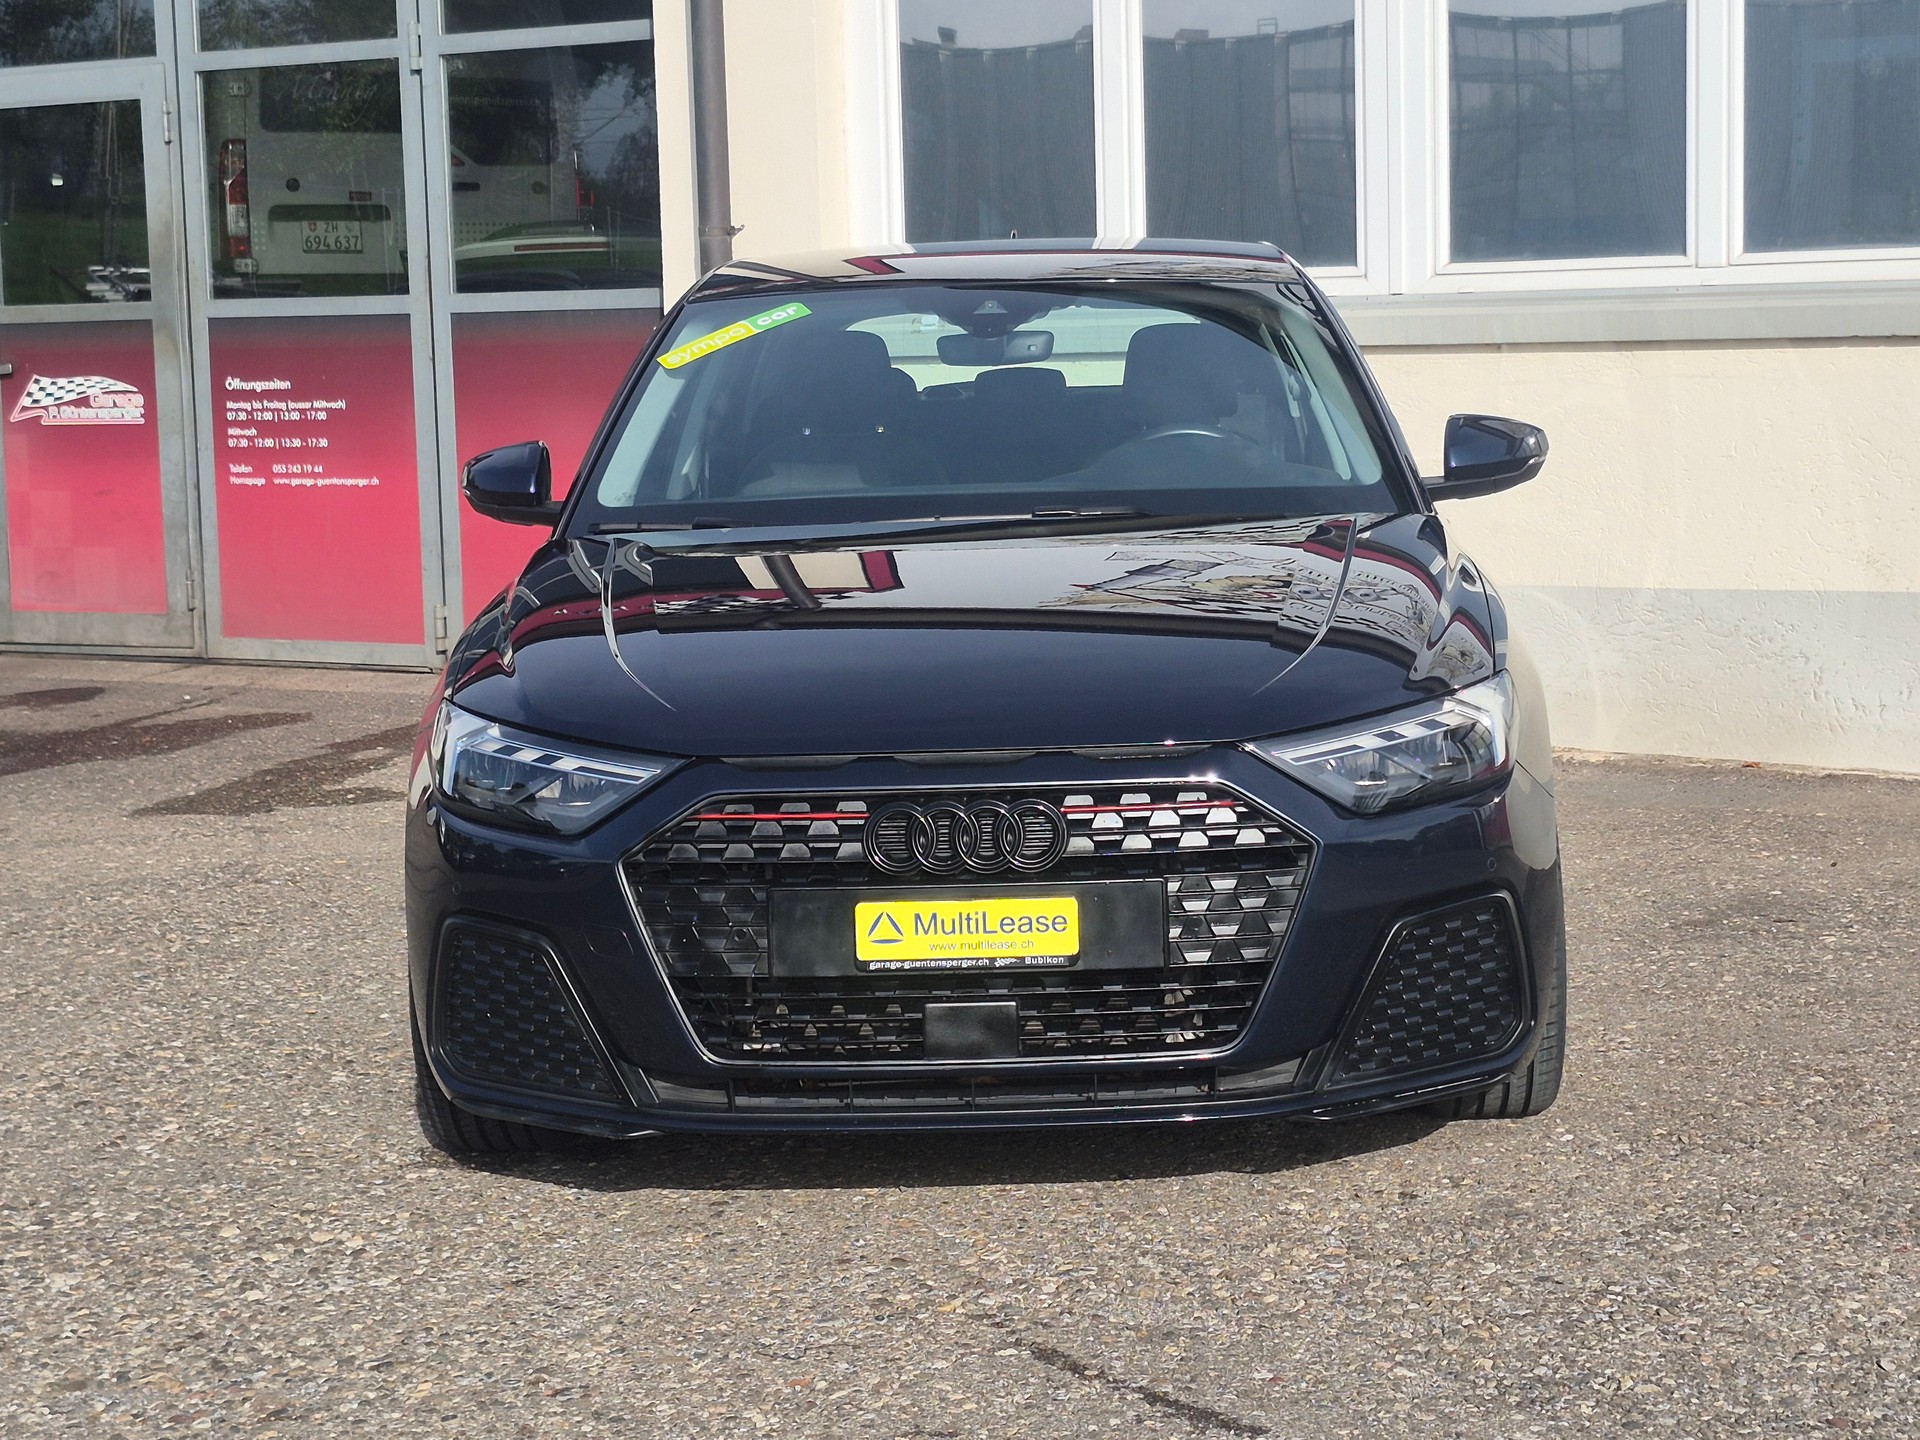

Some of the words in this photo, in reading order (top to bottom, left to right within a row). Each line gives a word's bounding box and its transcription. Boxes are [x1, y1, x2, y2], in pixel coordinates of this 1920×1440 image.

[324, 222, 339, 233] ZH
[305, 235, 331, 249] 694
[334, 235, 359, 249] 637
[667, 325, 747, 365] sympa
[756, 305, 798, 326] car
[225, 376, 291, 392] Öffnungszeiten
[90, 393, 144, 408] Garage
[227, 401, 251, 411] Montag
[252, 400, 262, 409] bis
[263, 400, 287, 411] Freitag
[227, 411, 247, 420] 07:30
[253, 411, 273, 420] 12:00
[280, 411, 300, 420] 13:00
[306, 411, 327, 420] 17:00
[227, 426, 257, 436] Mittwoch
[228, 438, 248, 447] 07:30
[254, 438, 274, 447] 12:00
[281, 438, 301, 447] 13:30
[307, 438, 328, 447] 17:30
[229, 464, 253, 473] Telefon
[272, 464, 287, 473] 055
[288, 464, 301, 473] 243
[303, 464, 312, 473] 19
[313, 465, 323, 473] 44
[230, 476, 266, 486] Homepage
[914, 910, 1068, 935] MultiLease
[929, 939, 1034, 951] www.multilease.ch
[869, 958, 989, 970] garage-guentensperger.ch
[1024, 956, 1064, 965] Bubikon
